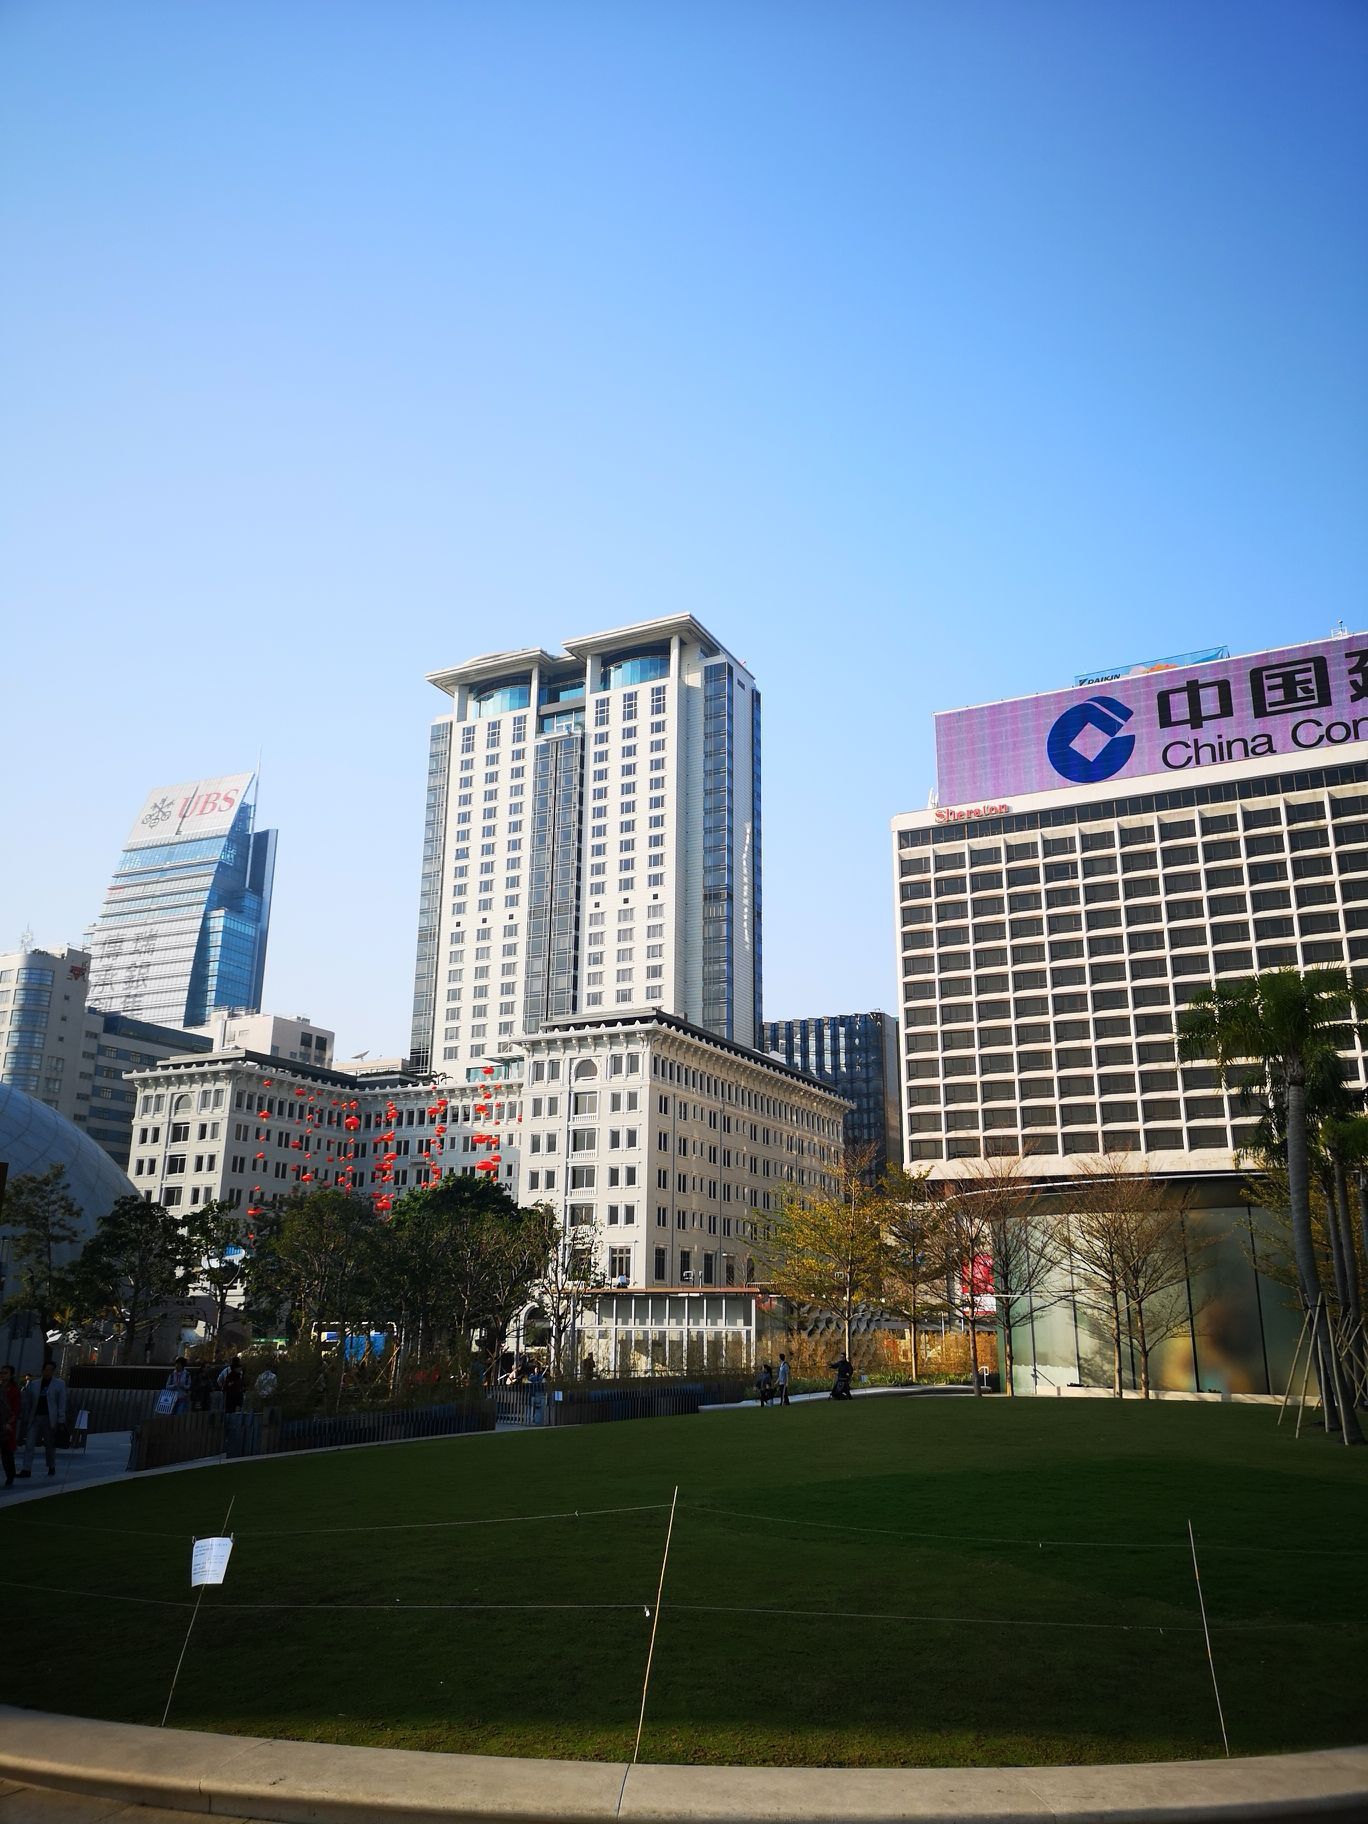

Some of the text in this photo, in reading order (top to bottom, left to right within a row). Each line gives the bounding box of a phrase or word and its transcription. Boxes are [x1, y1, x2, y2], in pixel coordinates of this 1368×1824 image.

[1088, 674, 1121, 685] DAIKIN
[1162, 733, 1277, 769] China
[177, 788, 240, 819] UBS
[935, 804, 1009, 823] Sheraton
